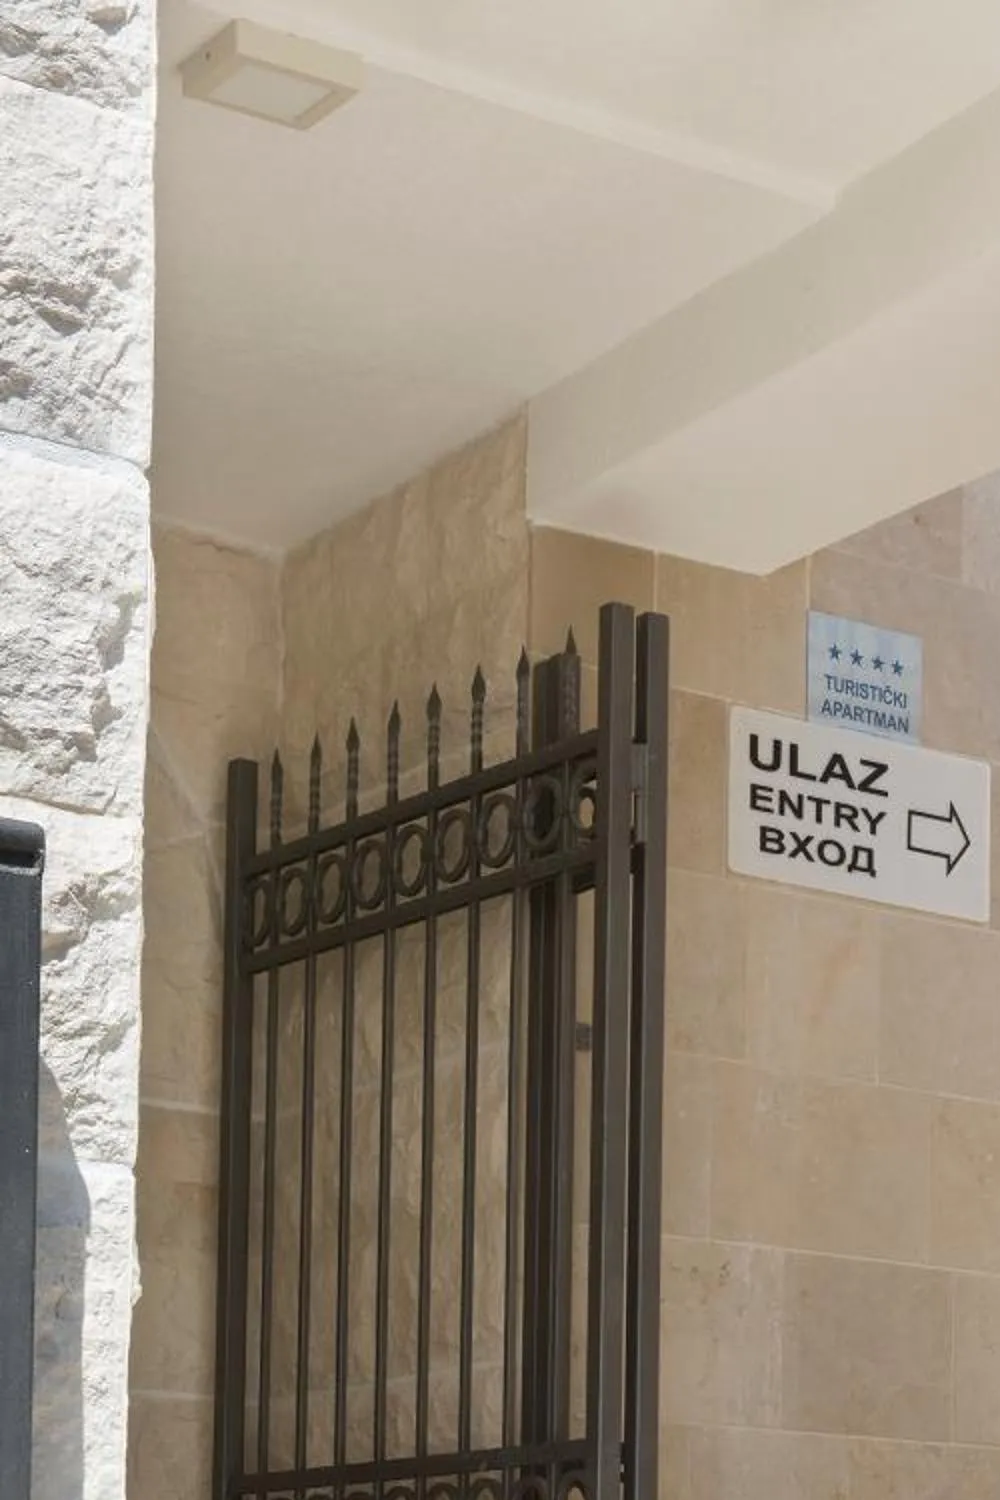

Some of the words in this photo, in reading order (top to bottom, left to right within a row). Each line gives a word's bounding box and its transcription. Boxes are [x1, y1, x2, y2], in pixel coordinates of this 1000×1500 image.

[821, 698, 910, 734] APARTMAN
[823, 673, 907, 709] TURISTIČKI
[749, 733, 889, 797] ULAZ
[749, 782, 887, 836] ENTRY
[758, 825, 876, 878] ВХОД
